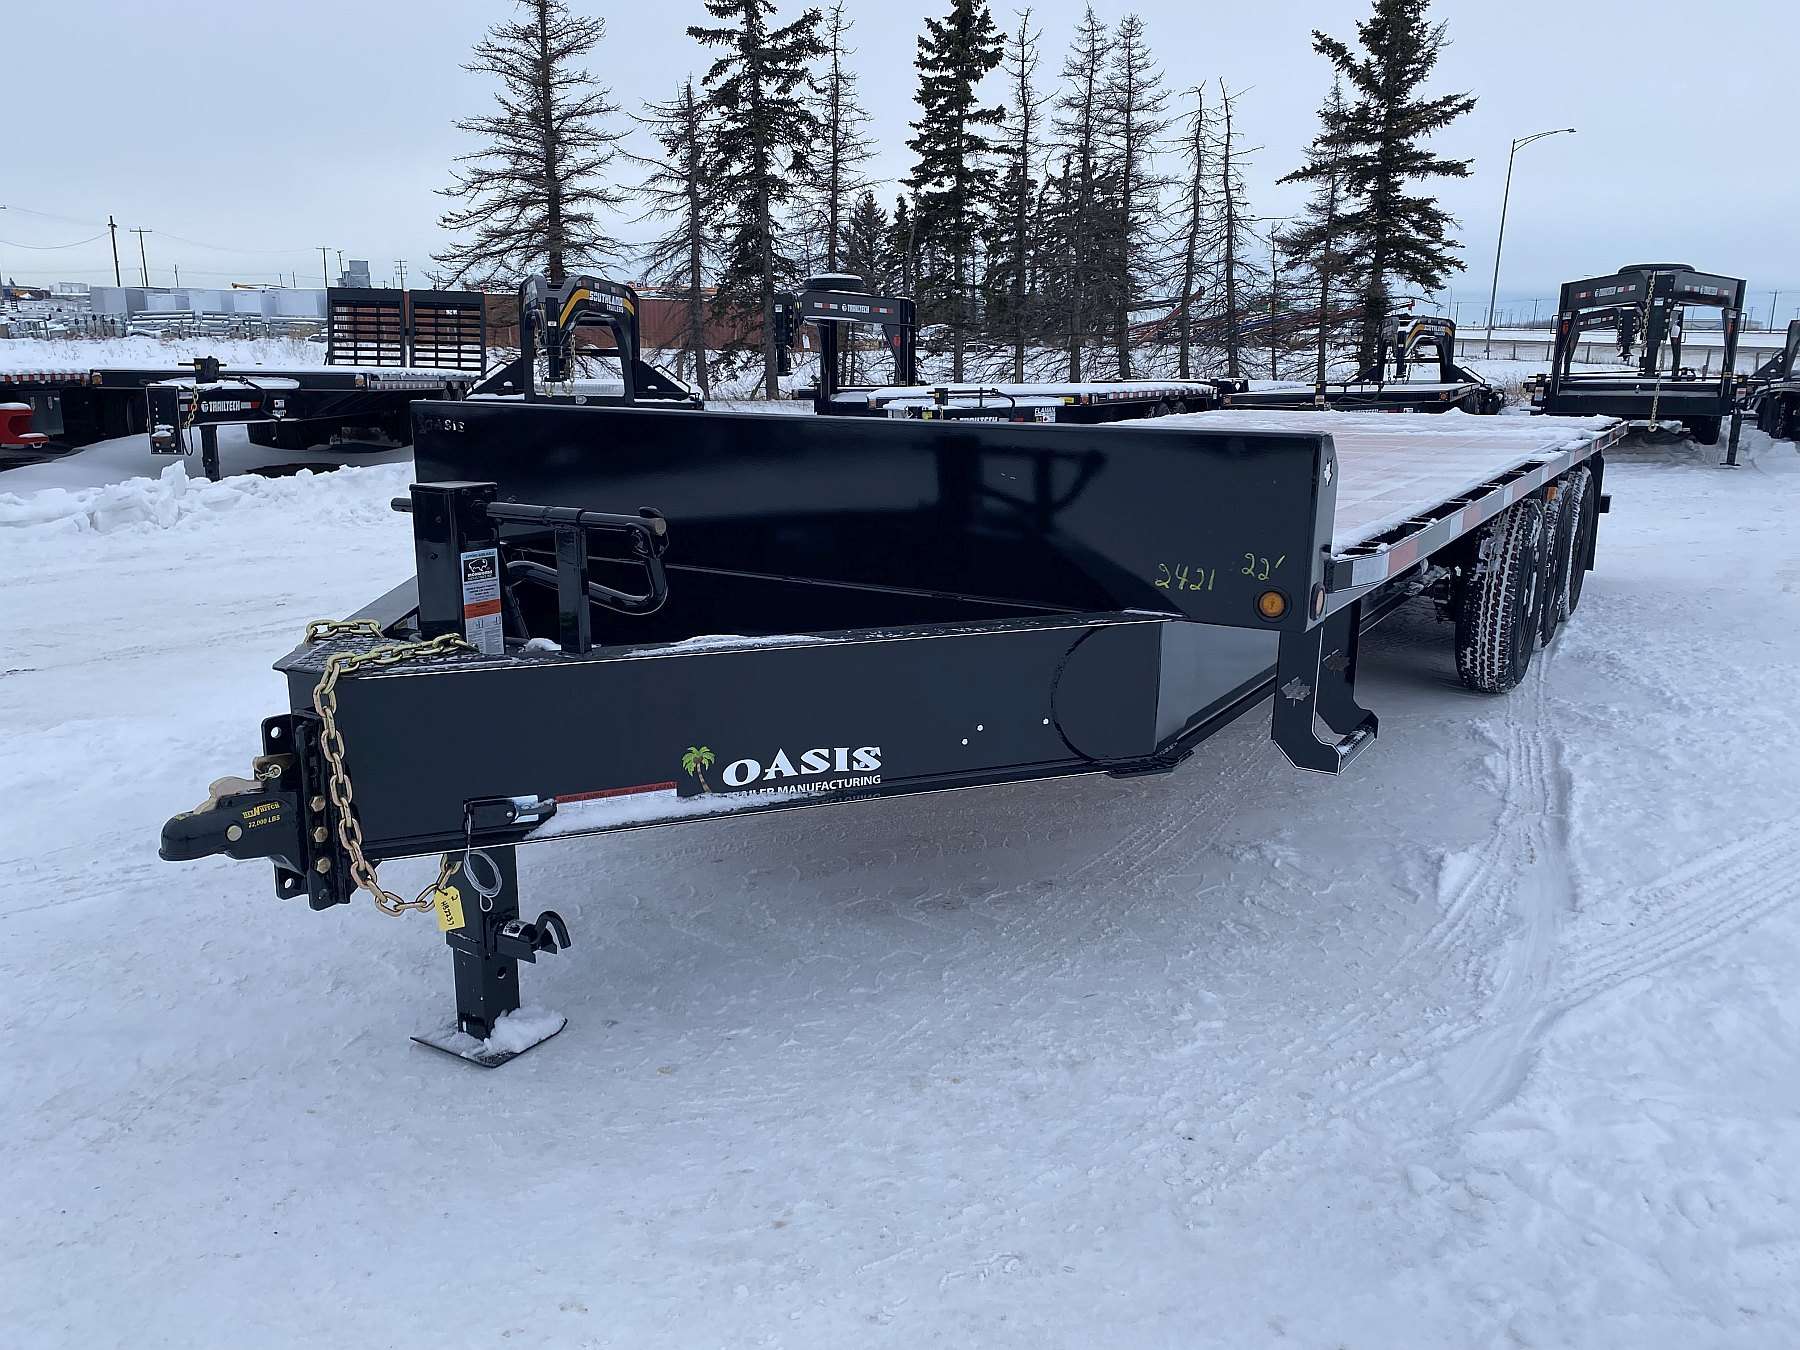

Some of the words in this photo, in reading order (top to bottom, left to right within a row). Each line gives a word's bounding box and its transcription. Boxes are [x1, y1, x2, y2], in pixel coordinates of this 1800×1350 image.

[209, 401, 240, 412] TRAILTECH
[1154, 563, 1216, 591] 2421
[722, 746, 882, 787] OASIS
[777, 774, 881, 794] MANUFACTURING
[268, 814, 281, 823] LBS
